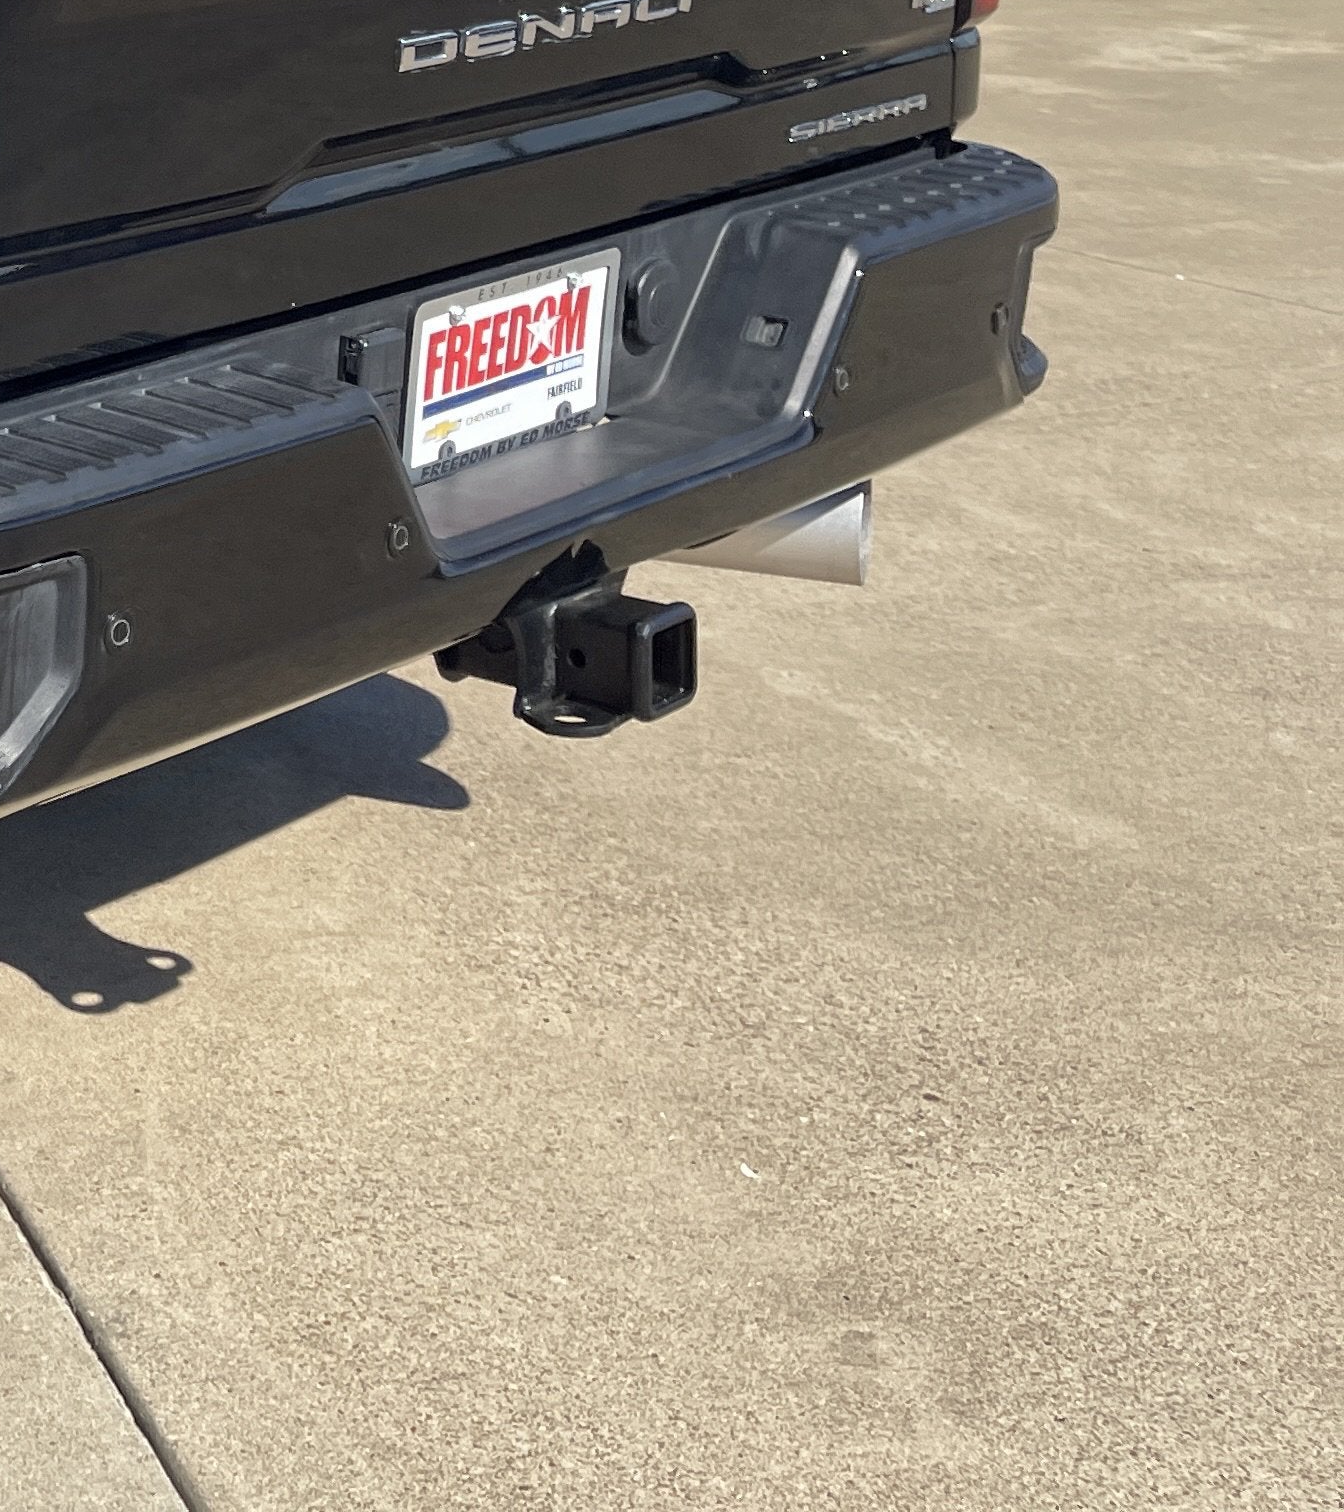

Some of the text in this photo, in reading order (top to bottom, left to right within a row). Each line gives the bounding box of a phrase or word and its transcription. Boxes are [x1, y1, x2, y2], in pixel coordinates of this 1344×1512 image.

[788, 94, 927, 142] SIERRA
[424, 285, 591, 402] FREEDOM
[546, 377, 583, 400] FAIRFIELD
[465, 403, 512, 426] CHEVROLET
[420, 411, 591, 480] FREEDOM BY ED MORSE
